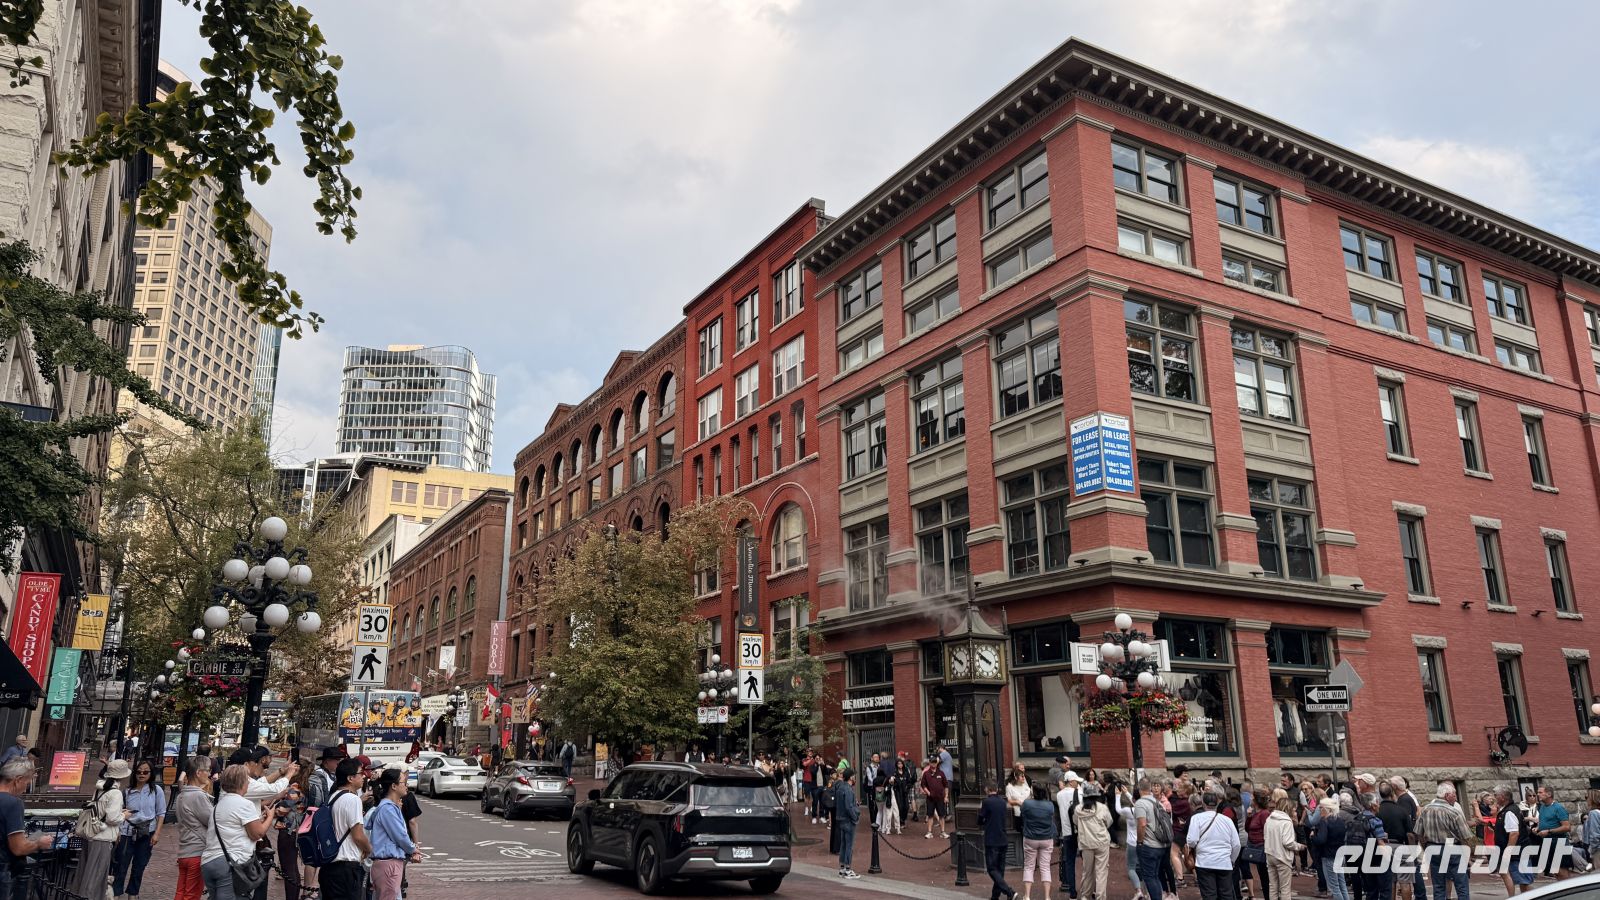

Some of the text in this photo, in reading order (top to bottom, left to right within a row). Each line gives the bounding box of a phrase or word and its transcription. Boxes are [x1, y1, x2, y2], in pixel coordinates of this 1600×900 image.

[1072, 430, 1098, 446] FOR LEASE
[1103, 430, 1129, 441] FOR LEASE
[28, 594, 44, 632] CANDY
[361, 614, 388, 633] 30
[490, 638, 498, 668] PORTO
[743, 643, 761, 658] 30
[194, 663, 227, 673] CAMBIE
